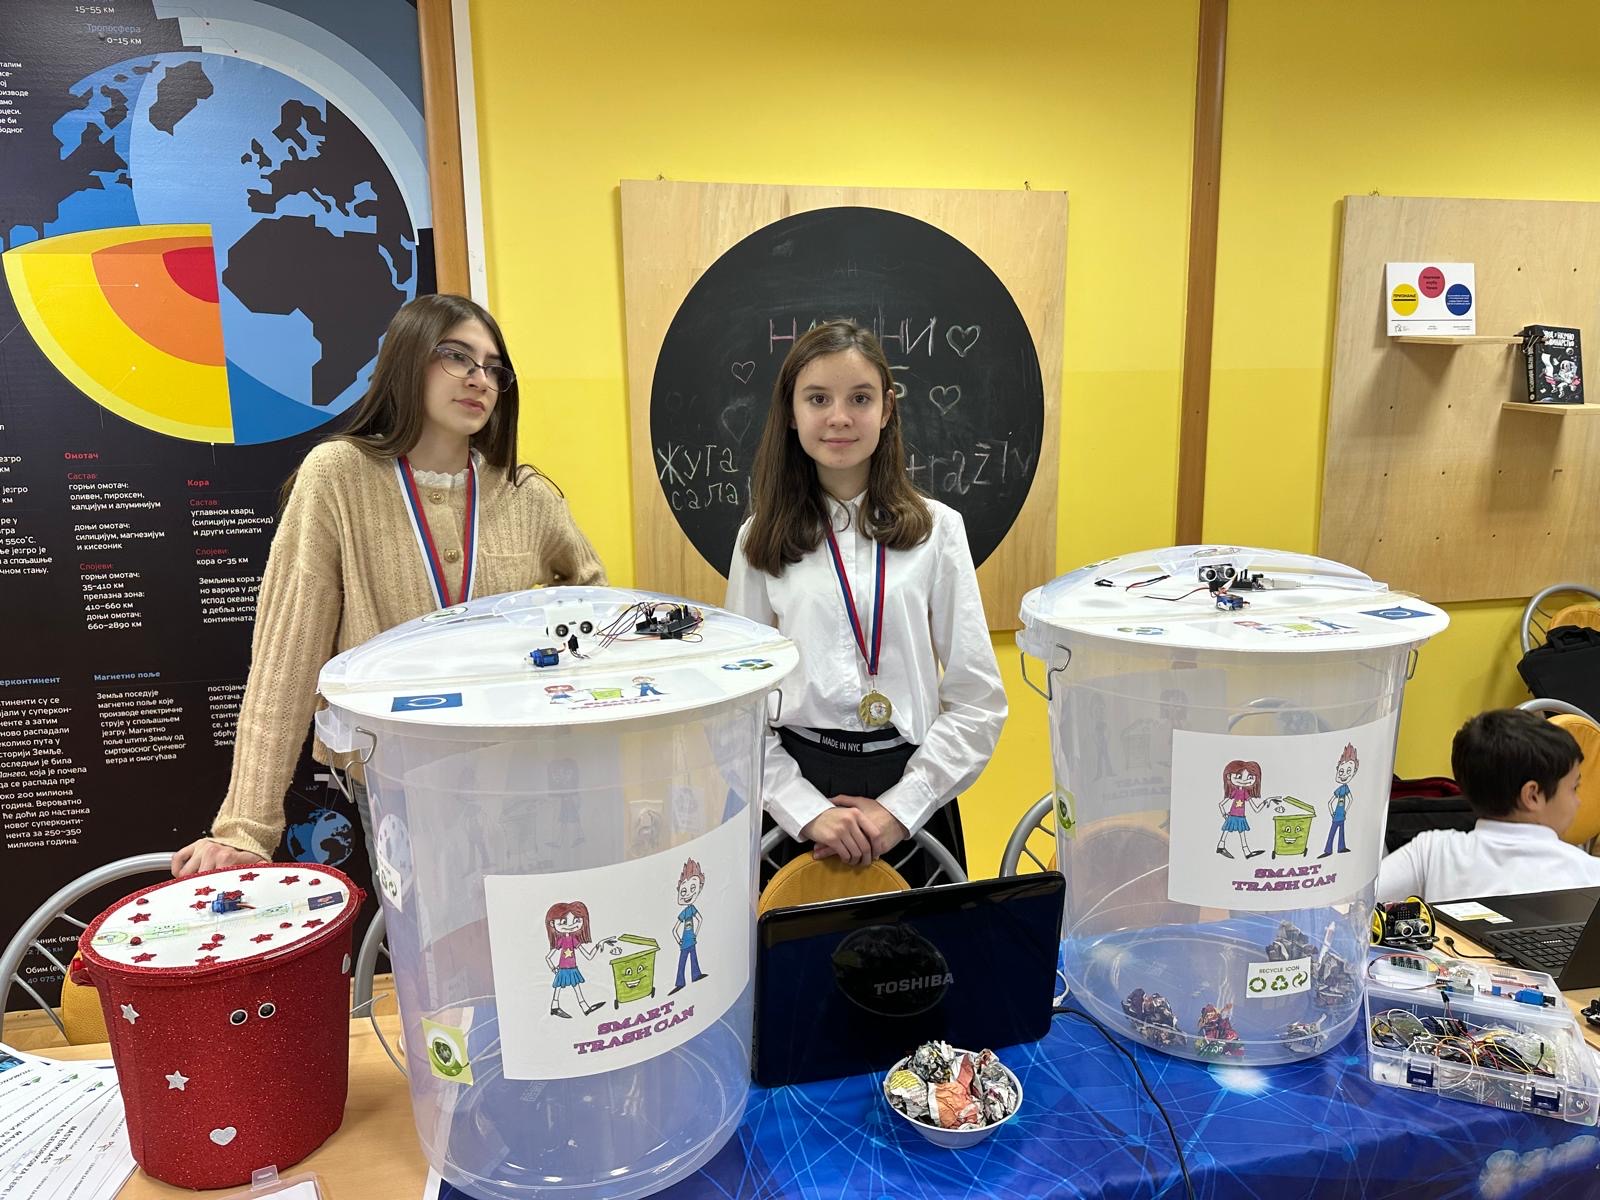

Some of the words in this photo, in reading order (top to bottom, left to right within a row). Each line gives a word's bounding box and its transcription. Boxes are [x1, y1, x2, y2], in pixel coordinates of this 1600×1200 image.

[87, 23, 141, 34] Тропосфера
[68, 483, 95, 491] горњи
[672, 477, 753, 511] сала
[71, 503, 107, 512] калцијум
[115, 501, 161, 509] алуминијум
[191, 509, 229, 517] углавном
[191, 518, 235, 527] (силицијум
[238, 516, 274, 524] диоксид)
[74, 524, 97, 532] доњи
[120, 531, 165, 539] магнезијум
[200, 529, 224, 537] други
[196, 558, 215, 566] кора
[199, 577, 235, 585] Земљина
[236, 576, 255, 584] кора
[83, 593, 122, 601] прелазна
[201, 597, 225, 605] испод
[94, 673, 135, 681] Магнетно
[96, 692, 123, 700] Земља
[124, 689, 159, 698] поседује
[38, 698, 48, 706] су
[98, 701, 135, 709] магнетно
[158, 698, 174, 706] које
[99, 710, 139, 719] производе
[100, 720, 124, 728] струје
[132, 716, 180, 725] спољашњем
[23, 727, 69, 737] распадали
[128, 726, 166, 734] Магнетно
[33, 738, 53, 746] пута
[822, 735, 839, 749] MADE
[839, 742, 847, 751] IN
[847, 743, 861, 752] NYC
[104, 746, 151, 756] смртоносног
[152, 743, 186, 752] Сунчевог
[105, 757, 128, 765] ветра
[136, 753, 177, 762] омогућава
[29, 769, 46, 777] која
[57, 767, 87, 775] почела
[22, 779, 57, 788] распада
[36, 789, 73, 797] милиона
[36, 799, 82, 807] Вероватно
[15, 810, 37, 819] доћи
[52, 807, 90, 816] настанка
[4, 821, 29, 829] новог
[6, 831, 31, 839] нента
[7, 841, 44, 849] милиона
[1254, 864, 1322, 879] SMART
[1231, 880, 1301, 892] TRASH
[1302, 873, 1337, 889] CAN
[873, 972, 955, 996] TOSHIBA
[597, 1001, 675, 1036] SMART
[573, 1024, 653, 1055] TRASH
[654, 1005, 695, 1033] CAN
